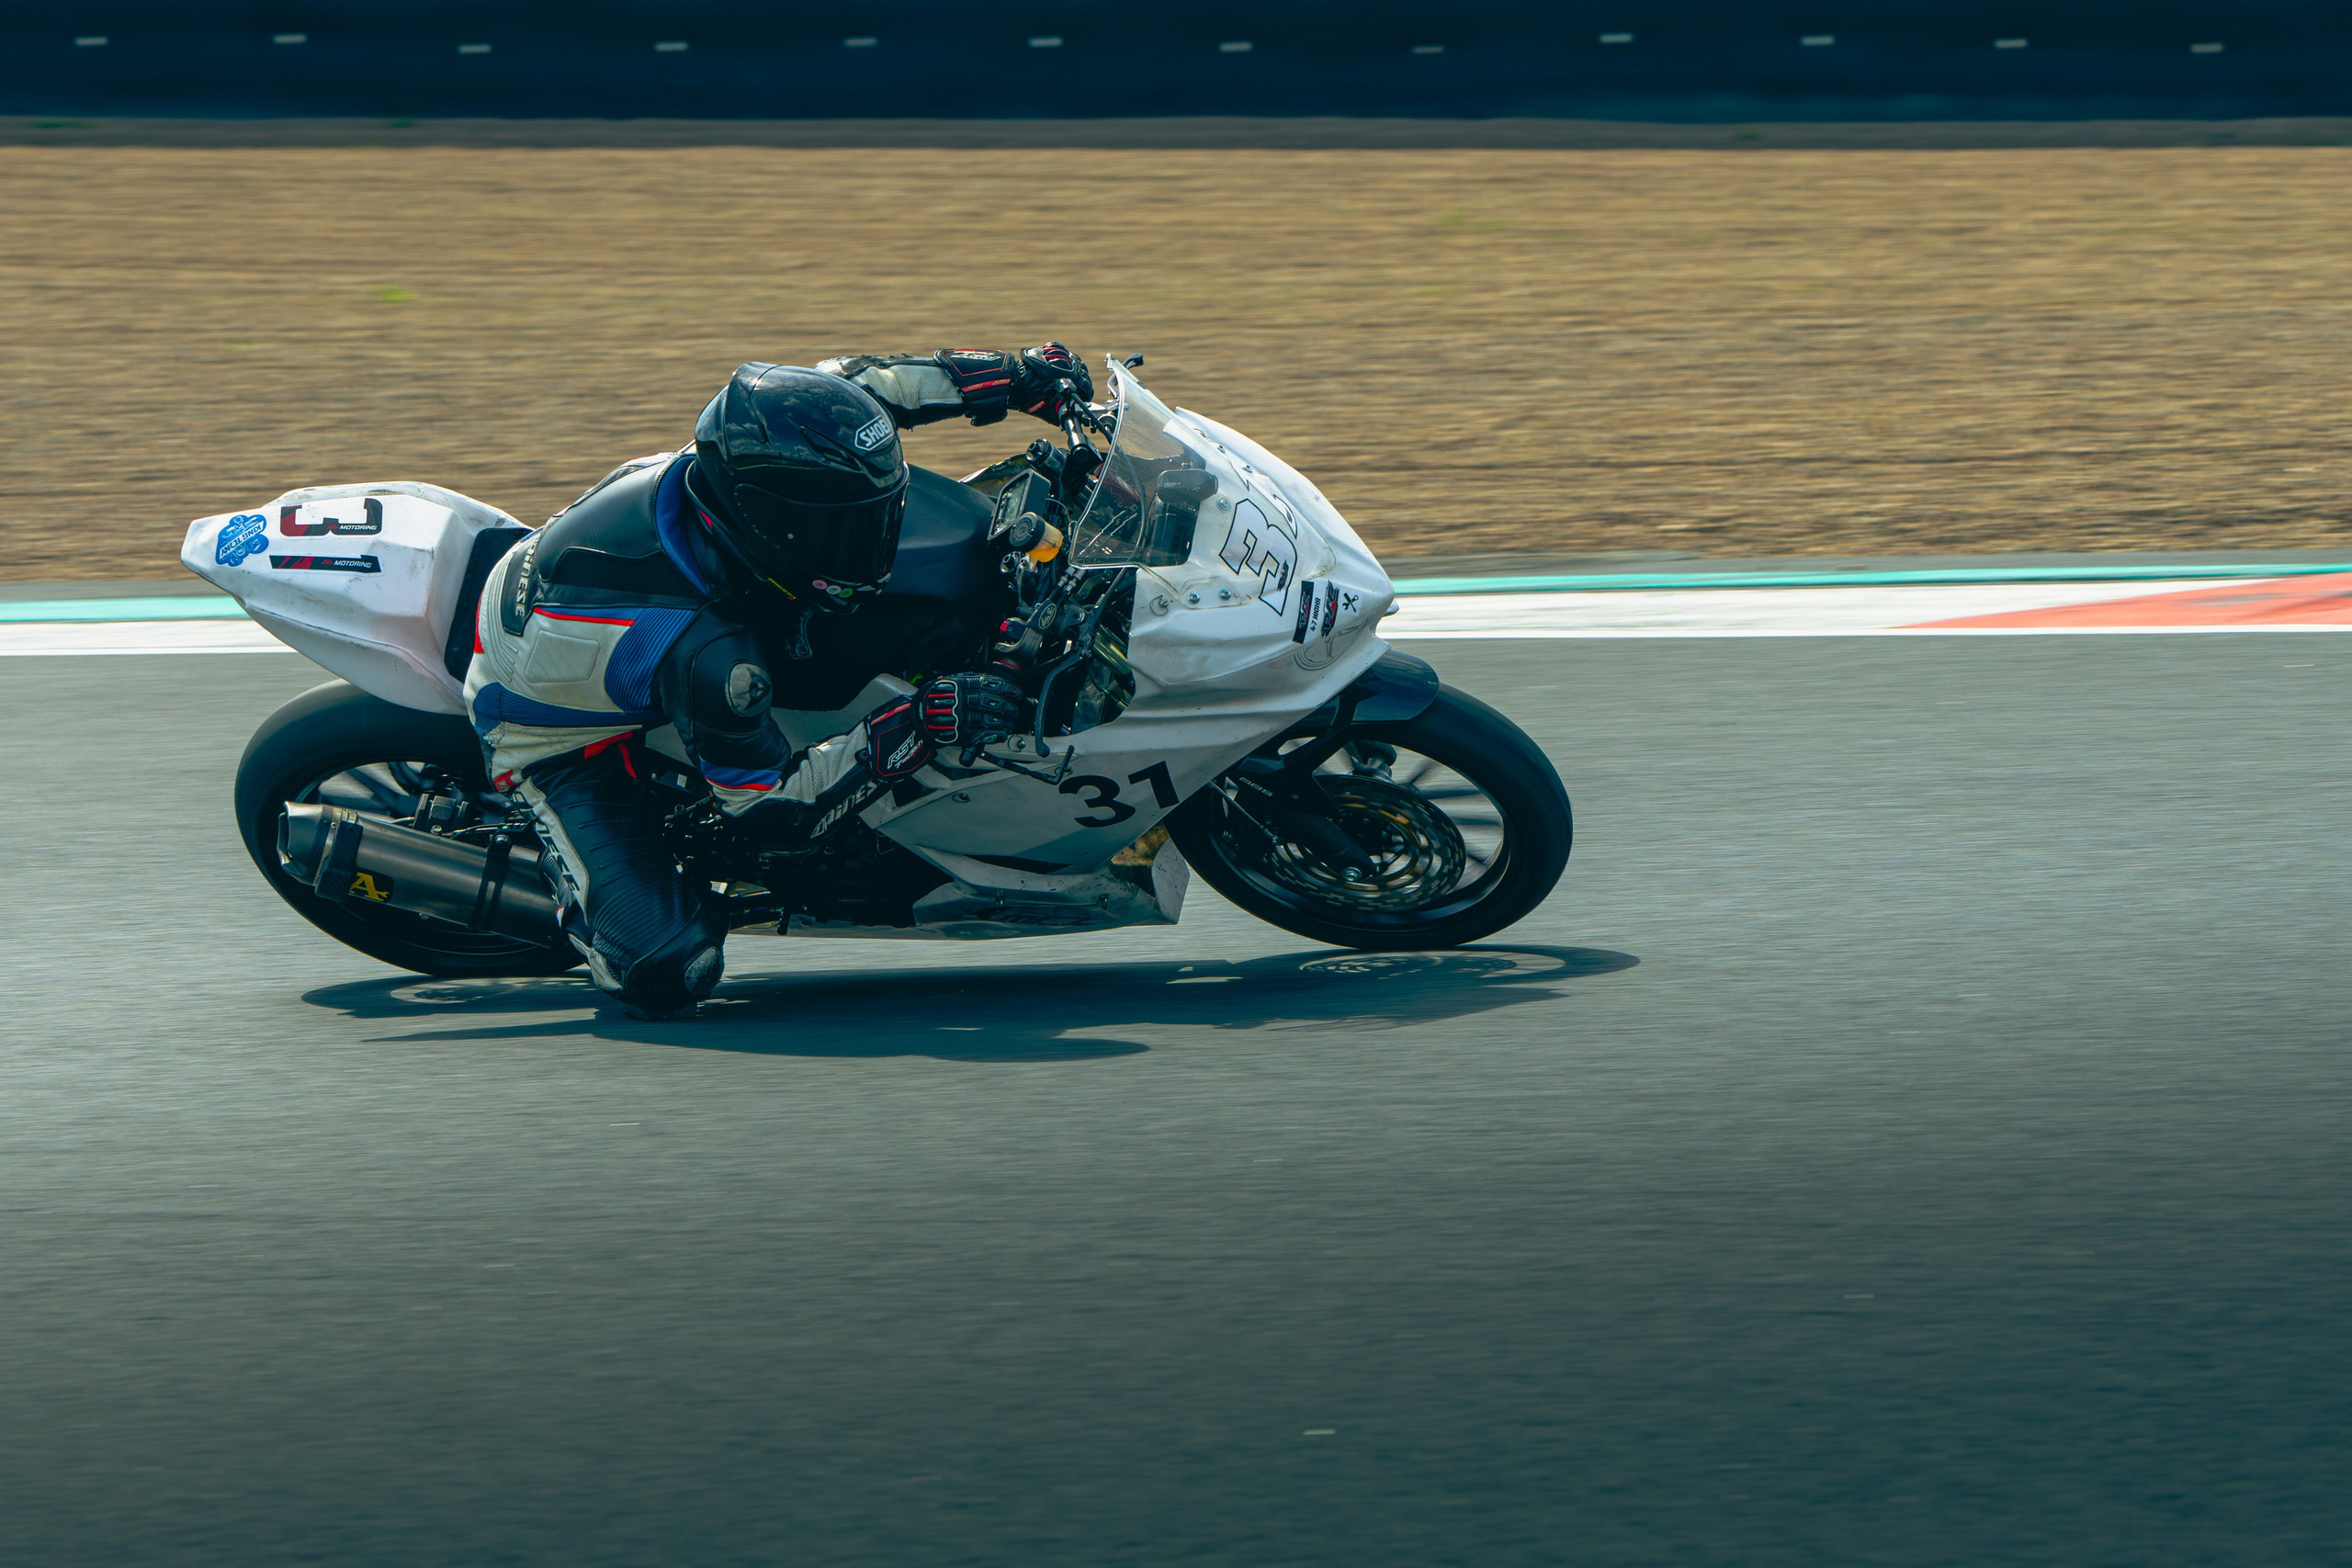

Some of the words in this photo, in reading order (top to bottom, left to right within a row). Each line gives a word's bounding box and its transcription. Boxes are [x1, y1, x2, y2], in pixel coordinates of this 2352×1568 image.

[859, 418, 891, 447] SHOEI
[243, 524, 262, 540] KING
[220, 538, 243, 556] TONY
[334, 559, 373, 569] MOTORING
[1313, 597, 1322, 621] ИЮНЯ
[1310, 620, 1318, 632] 4-7
[887, 729, 916, 770] RST
[1058, 761, 1181, 829] 31
